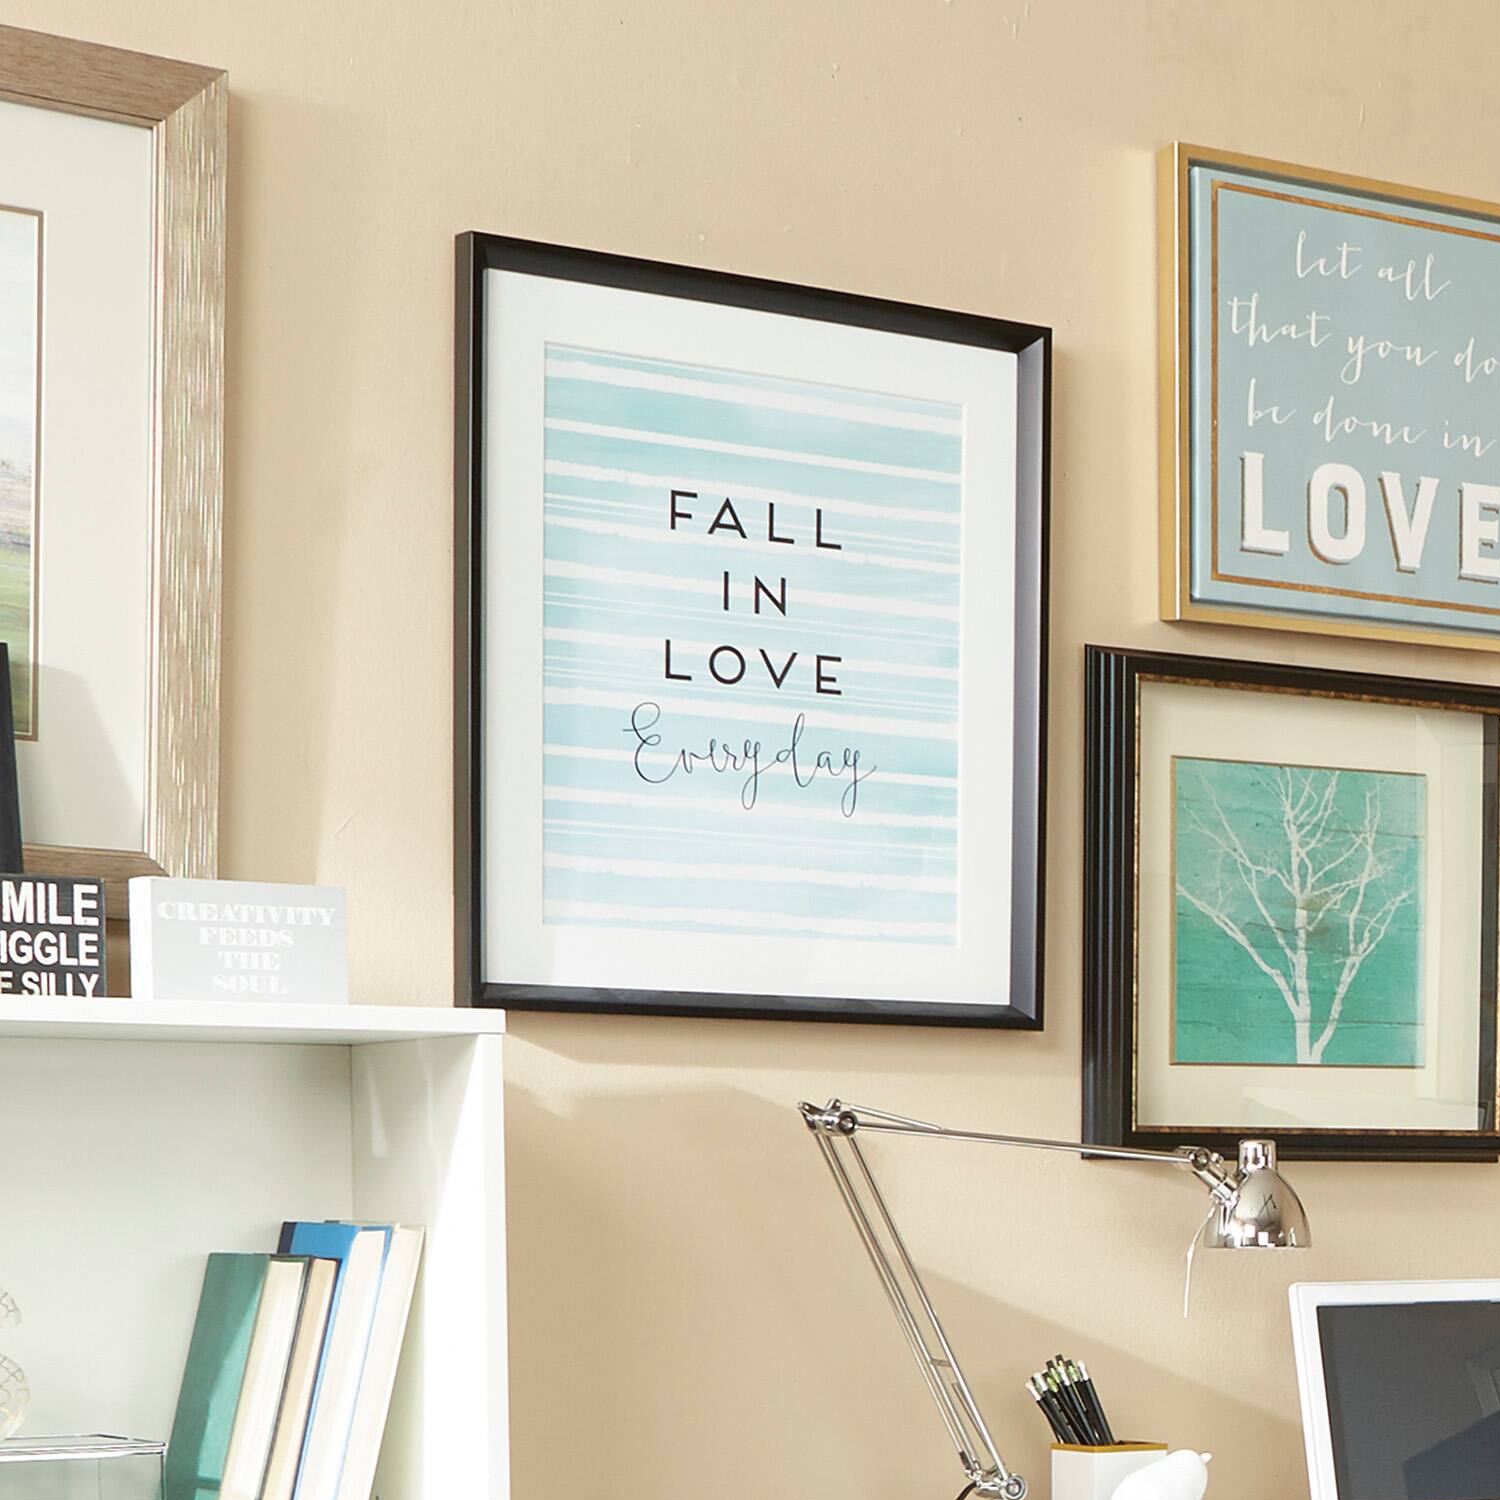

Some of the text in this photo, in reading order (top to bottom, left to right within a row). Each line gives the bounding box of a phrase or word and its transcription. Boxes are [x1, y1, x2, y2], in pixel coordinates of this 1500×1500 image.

[1296, 230, 1451, 301] let all
[1226, 292, 1332, 347] that
[1340, 335, 1439, 384] you
[1248, 377, 1497, 458] be done in
[670, 489, 842, 550] FALL
[723, 571, 786, 616] IN
[664, 639, 842, 695] LOVE
[622, 702, 877, 817] Everyday
[1, 880, 99, 927] MILE
[157, 901, 337, 926] CREATIVITY
[0, 930, 99, 967] IGGLE
[199, 926, 294, 948] FEEDS
[0, 970, 13, 995] E
[211, 974, 288, 994] SOUL
[217, 951, 281, 971] THE
